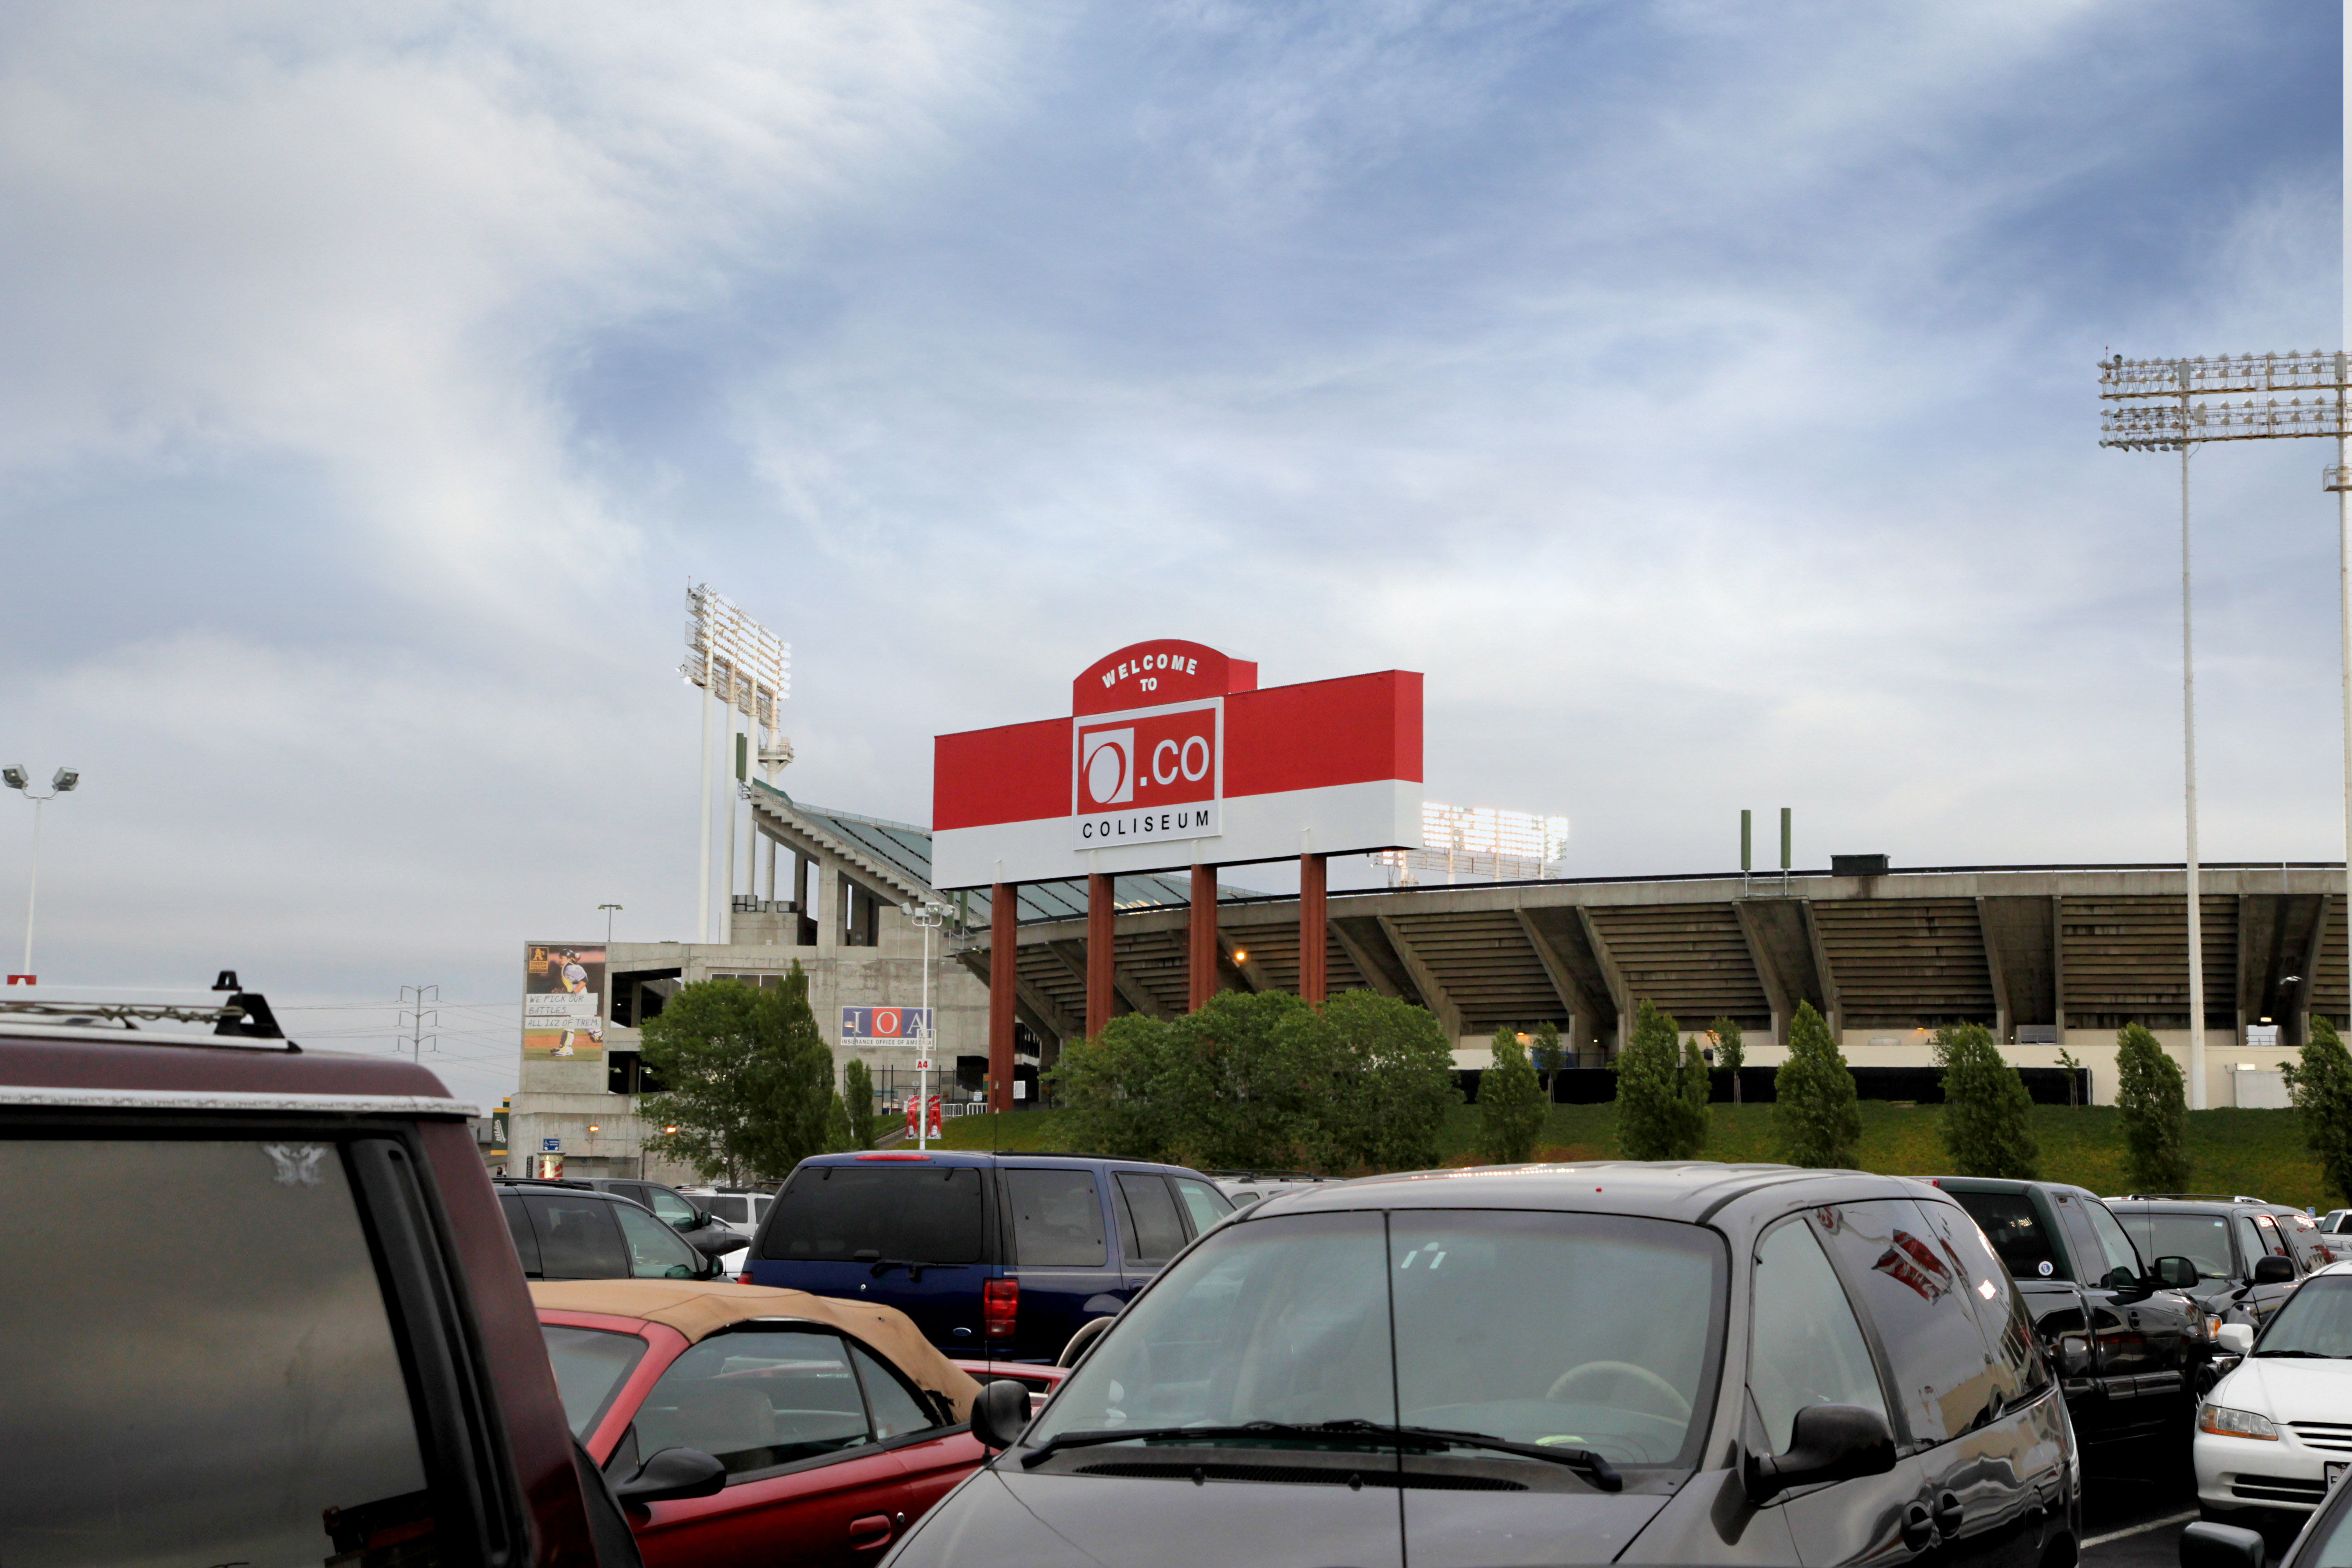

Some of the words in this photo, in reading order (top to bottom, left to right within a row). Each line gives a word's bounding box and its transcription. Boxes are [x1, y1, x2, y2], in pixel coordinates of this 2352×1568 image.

[1102, 654, 1197, 688] WELCOME
[1140, 677, 1157, 691] TO
[1083, 810, 1208, 838] COLISEUM
[852, 1011, 925, 1034] IOA
[917, 1060, 928, 1069] A4
